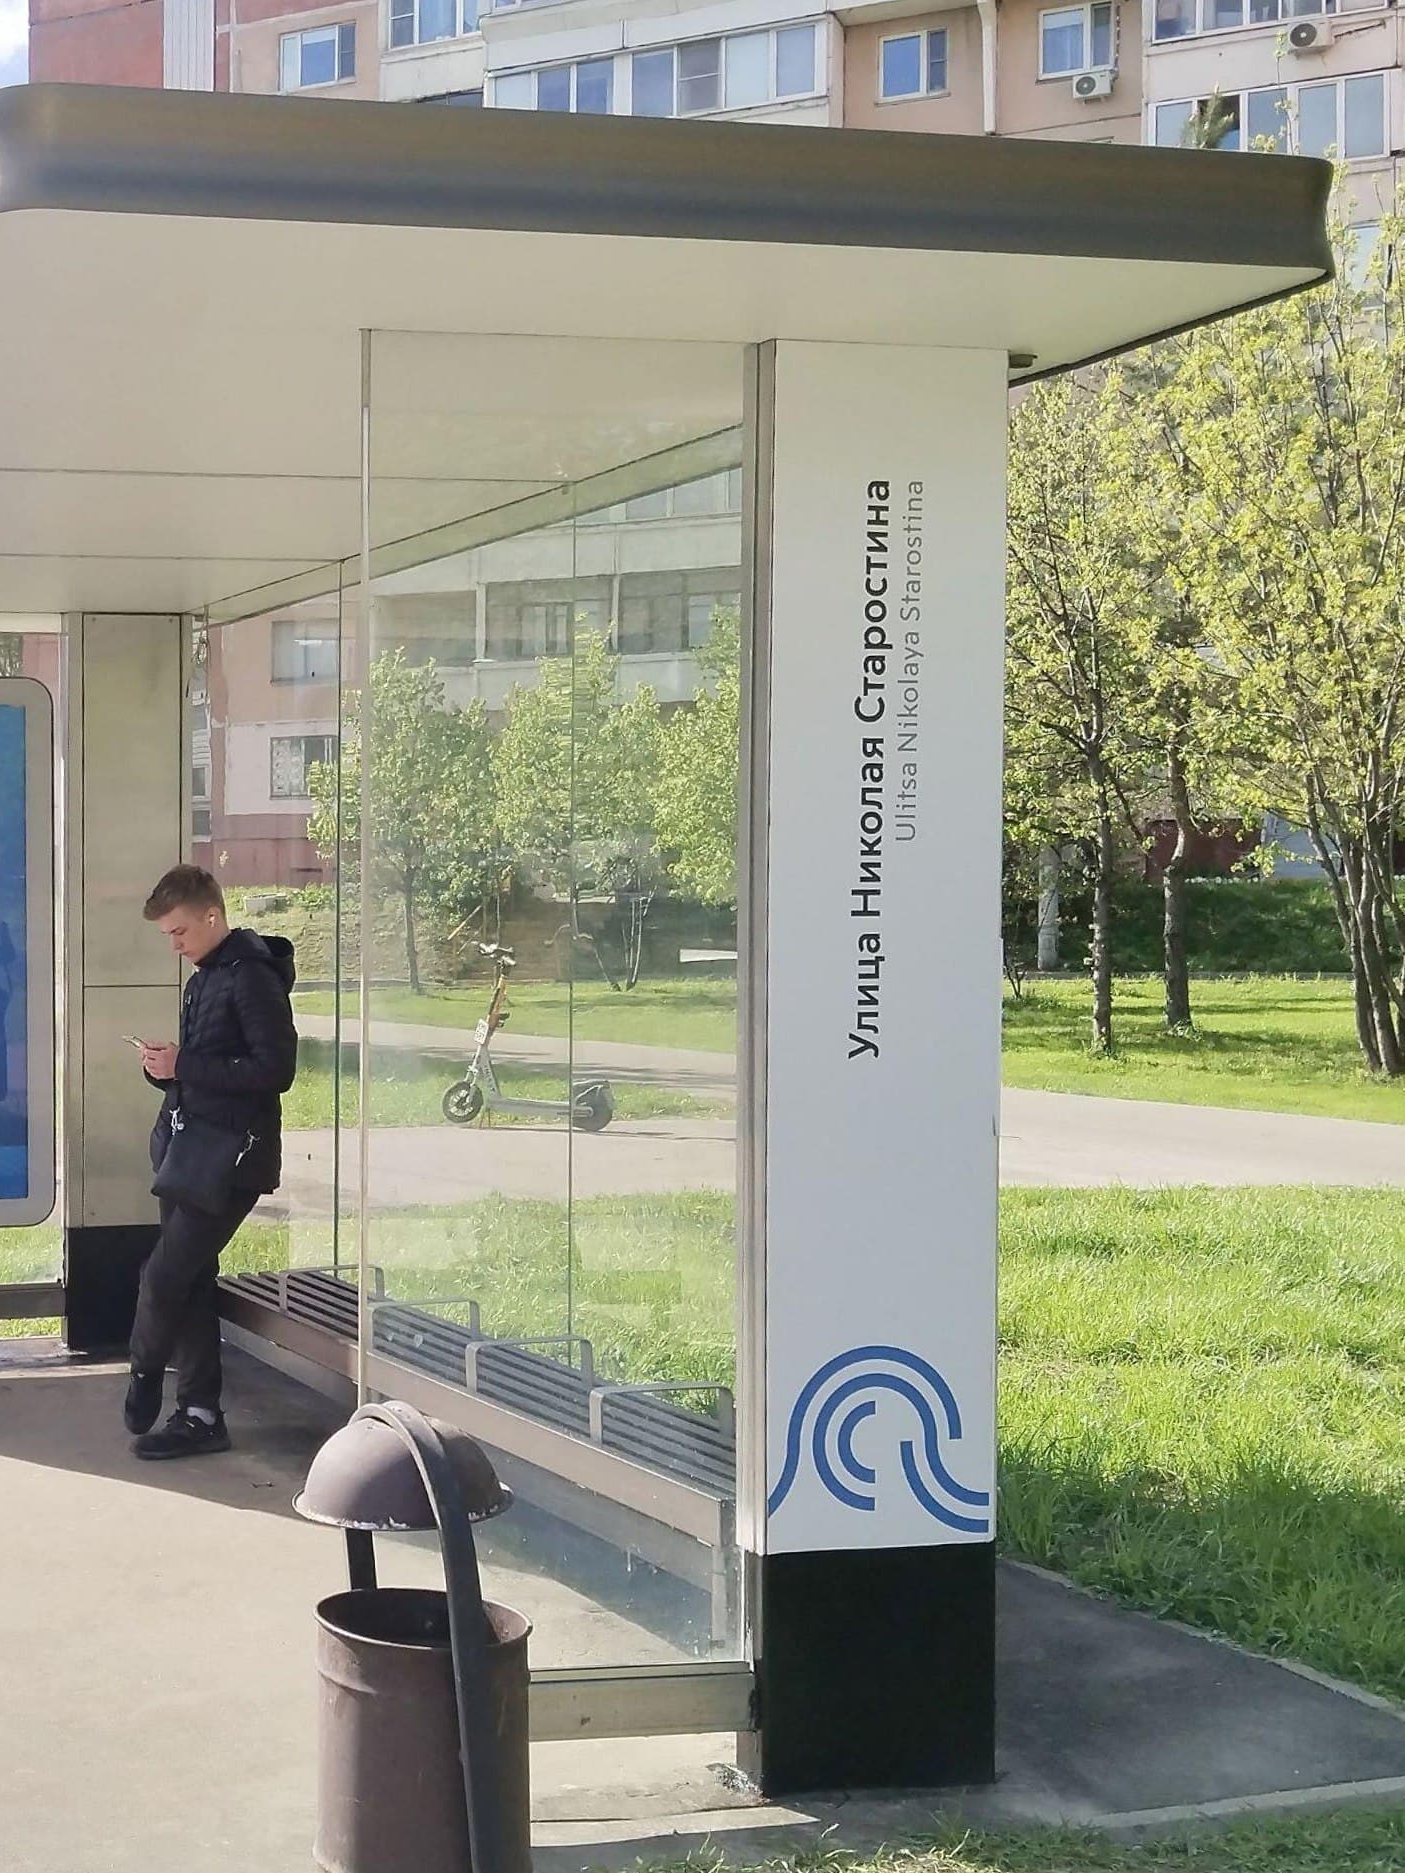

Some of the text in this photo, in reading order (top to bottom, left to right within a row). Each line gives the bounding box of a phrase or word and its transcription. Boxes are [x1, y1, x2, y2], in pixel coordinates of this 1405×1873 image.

[847, 479, 893, 1060] Улица Николая Старостина
[894, 480, 925, 842] Ulitsa Nikolaya Starostina
